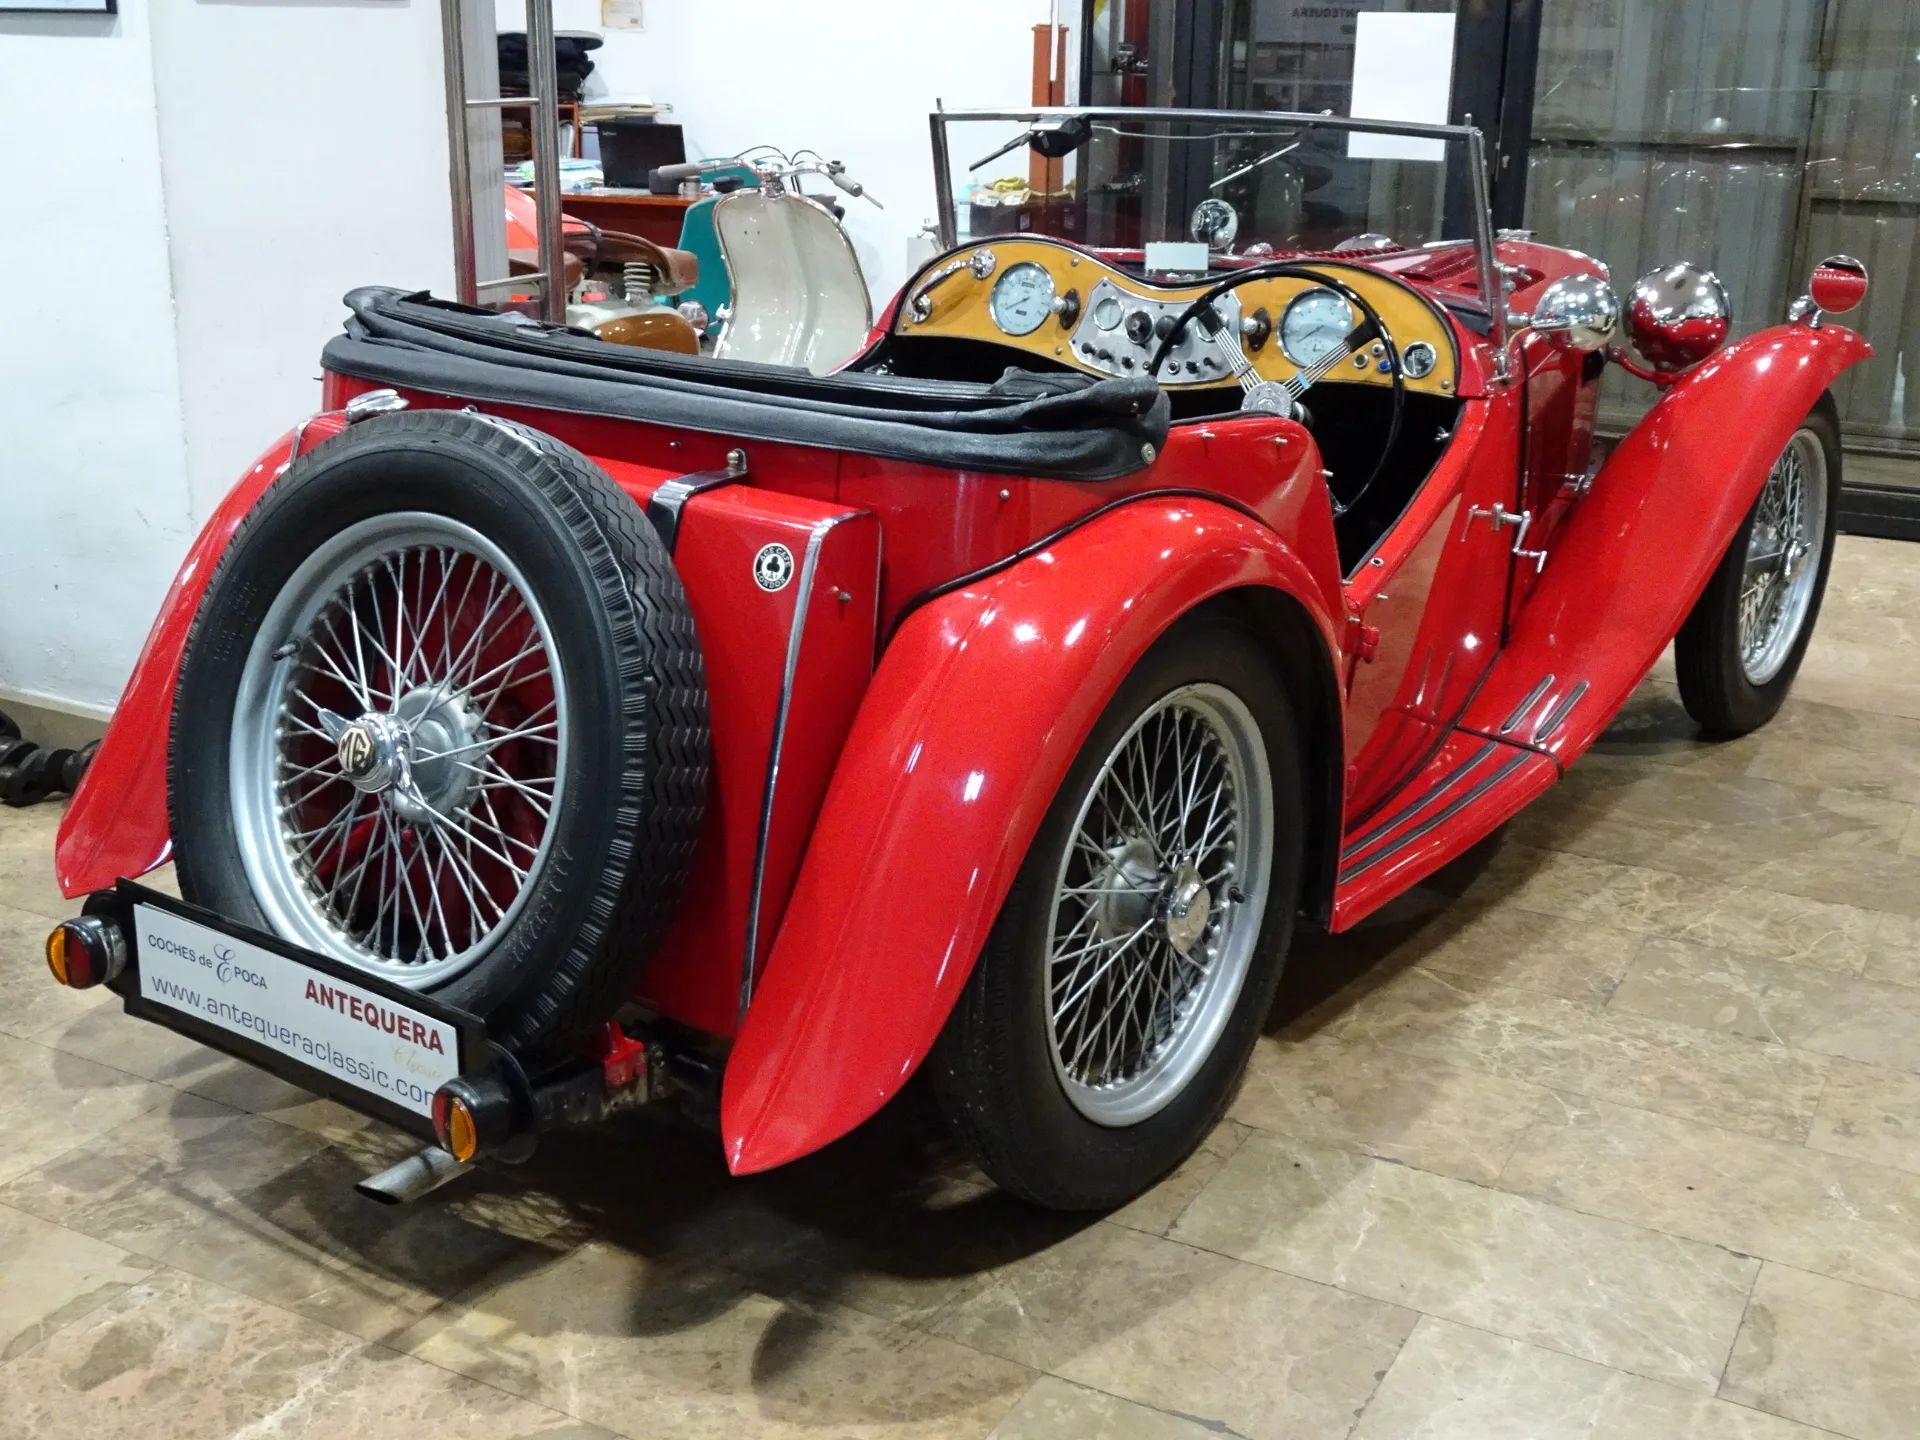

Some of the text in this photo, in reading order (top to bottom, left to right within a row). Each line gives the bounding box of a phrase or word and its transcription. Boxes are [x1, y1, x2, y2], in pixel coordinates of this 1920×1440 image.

[340, 729, 369, 771] MG
[148, 934, 196, 962] COCHES
[198, 954, 213, 968] de
[304, 978, 445, 1056] ANTEQUERA
